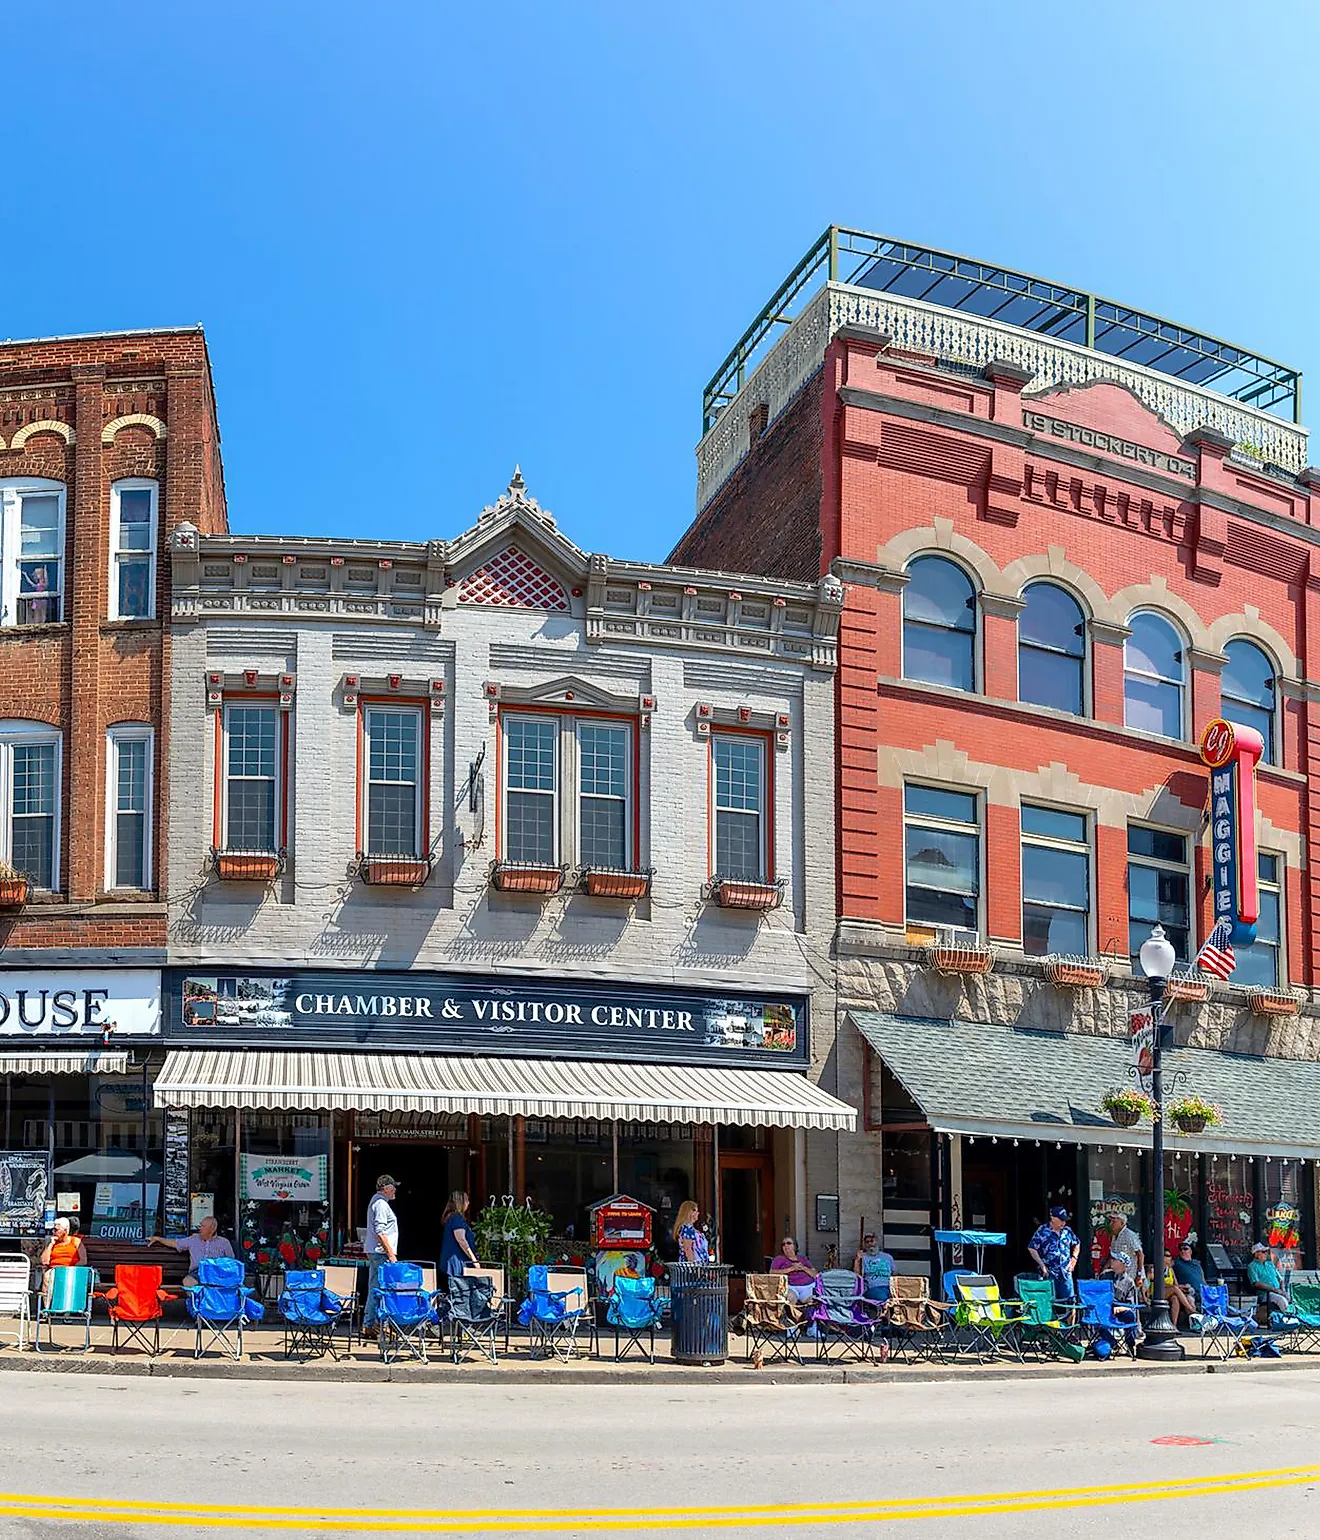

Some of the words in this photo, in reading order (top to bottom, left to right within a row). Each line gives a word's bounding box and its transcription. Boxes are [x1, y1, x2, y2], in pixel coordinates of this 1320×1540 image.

[1052, 420, 1162, 469] STOCKERT
[1167, 457, 1197, 480] 04
[1212, 772, 1233, 937] MAGGIES
[294, 993, 435, 1019] CHAMBER
[440, 997, 464, 1020] &
[471, 999, 585, 1026] VISITOR
[590, 1005, 695, 1032] CENTER
[264, 1166, 301, 1174] MARKET
[100, 1225, 143, 1239] COMING
[1166, 1220, 1181, 1239] Hi
